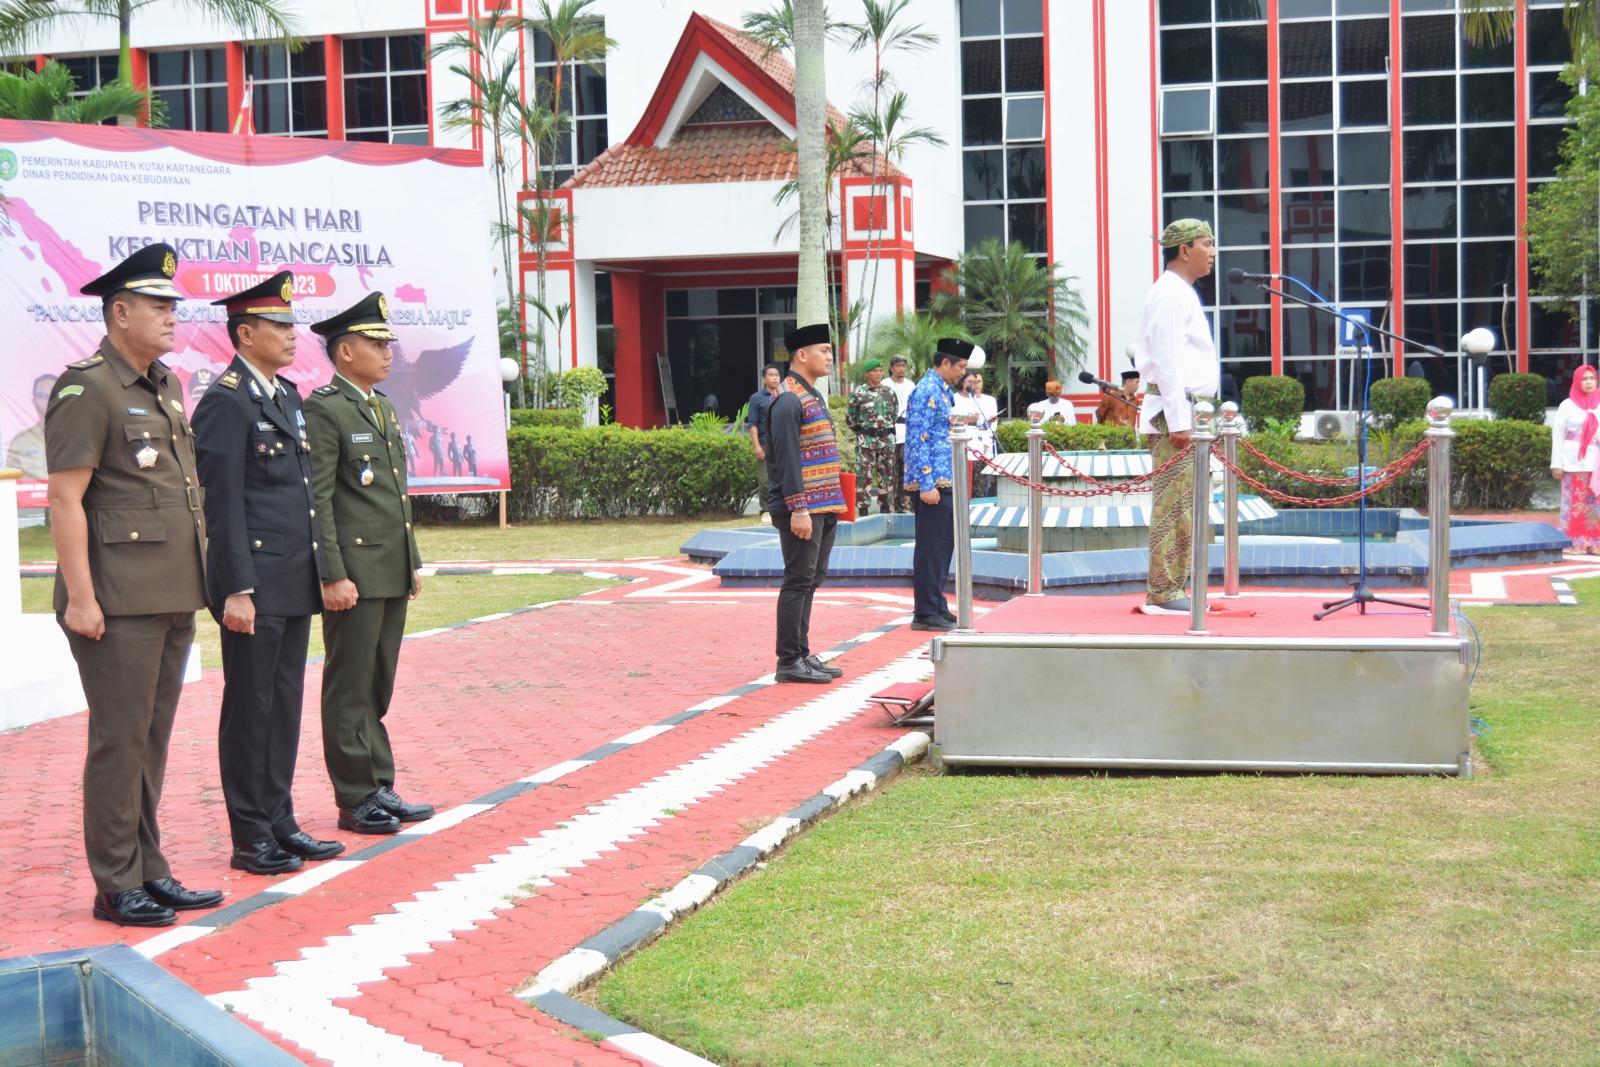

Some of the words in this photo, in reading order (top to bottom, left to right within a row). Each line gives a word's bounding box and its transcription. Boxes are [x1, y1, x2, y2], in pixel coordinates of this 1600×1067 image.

[22, 156, 80, 168] PEMERINTAH
[83, 159, 136, 170] KABUPATEN
[138, 161, 164, 172] KUTAI
[166, 163, 231, 175] KARTANEGARA
[22, 169, 51, 179] DINAS
[53, 171, 108, 182] PENDIDIKAN
[111, 173, 130, 182] DAN
[132, 174, 191, 186] KEBUDAYAAN
[138, 200, 298, 230] PERINGATAN
[304, 207, 362, 233] HARI
[108, 235, 252, 264] KESKTIAN
[259, 240, 394, 268] PANCASILA
[202, 272, 210, 292] 1
